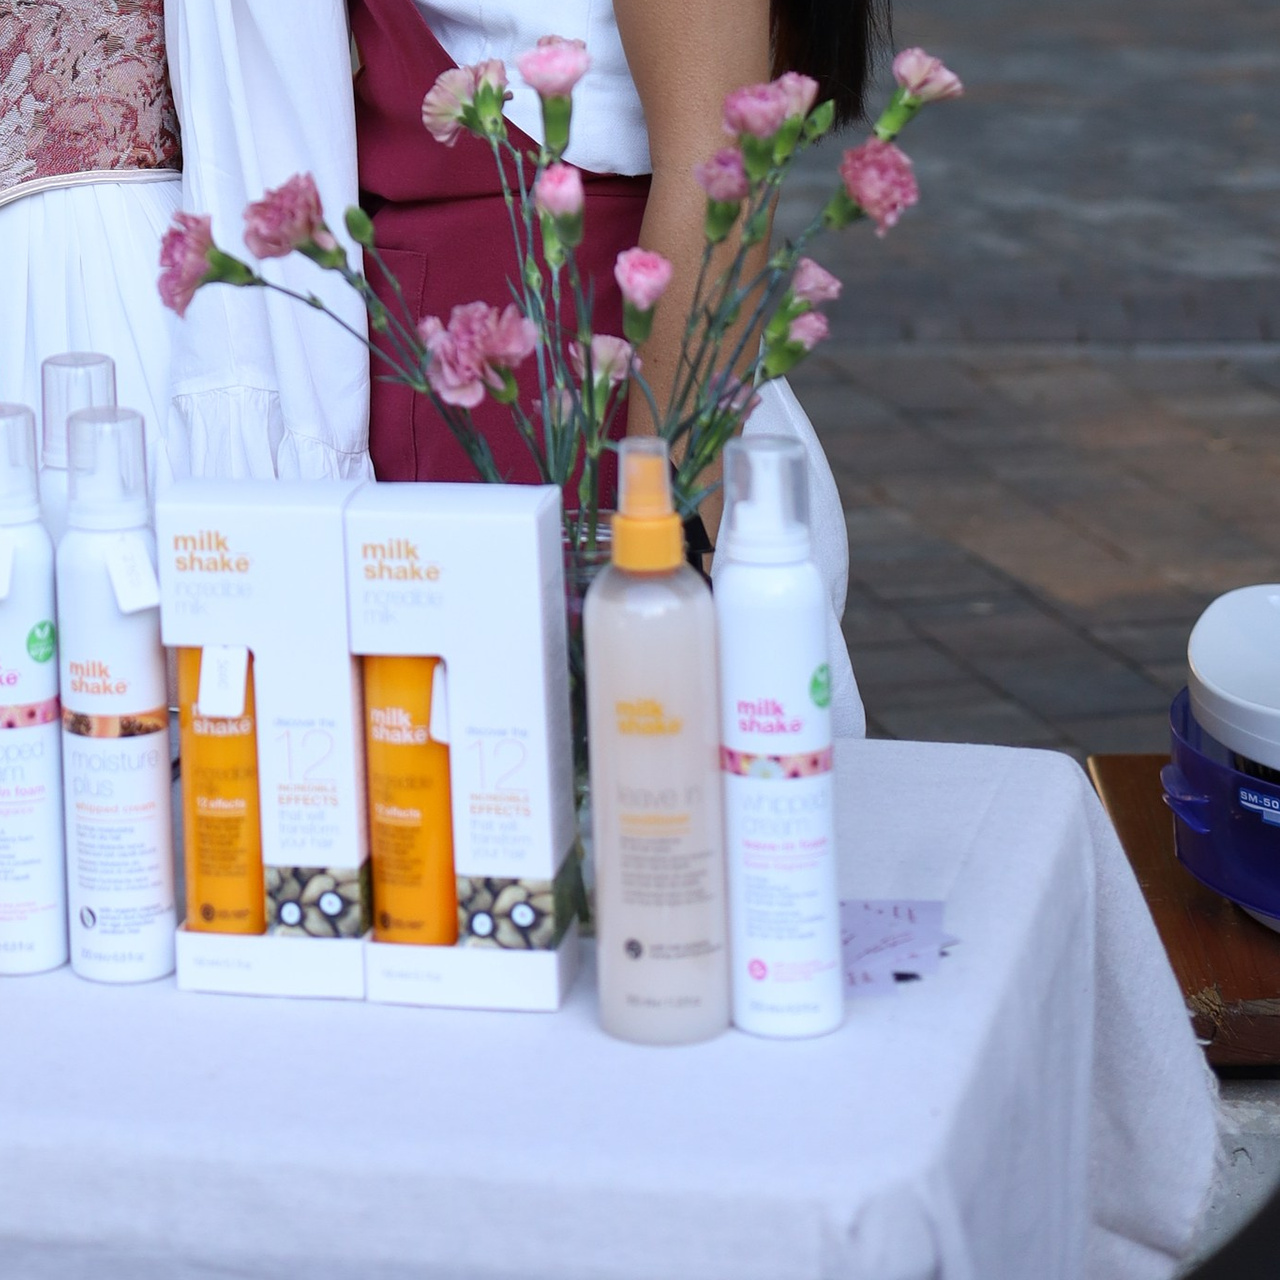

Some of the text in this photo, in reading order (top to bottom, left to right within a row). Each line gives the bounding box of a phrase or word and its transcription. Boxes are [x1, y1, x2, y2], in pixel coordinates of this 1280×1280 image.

[174, 531, 229, 551] milk
[363, 540, 419, 560] milk
[175, 552, 250, 572] shake
[364, 561, 440, 581] shake
[70, 661, 110, 678] milk
[71, 678, 128, 695] shake
[737, 701, 784, 716] milk
[193, 717, 251, 735] shake
[371, 709, 411, 726] milk
[739, 717, 802, 733] shake
[278, 794, 339, 806] EFFECTS
[470, 804, 531, 816] EFFECTS
